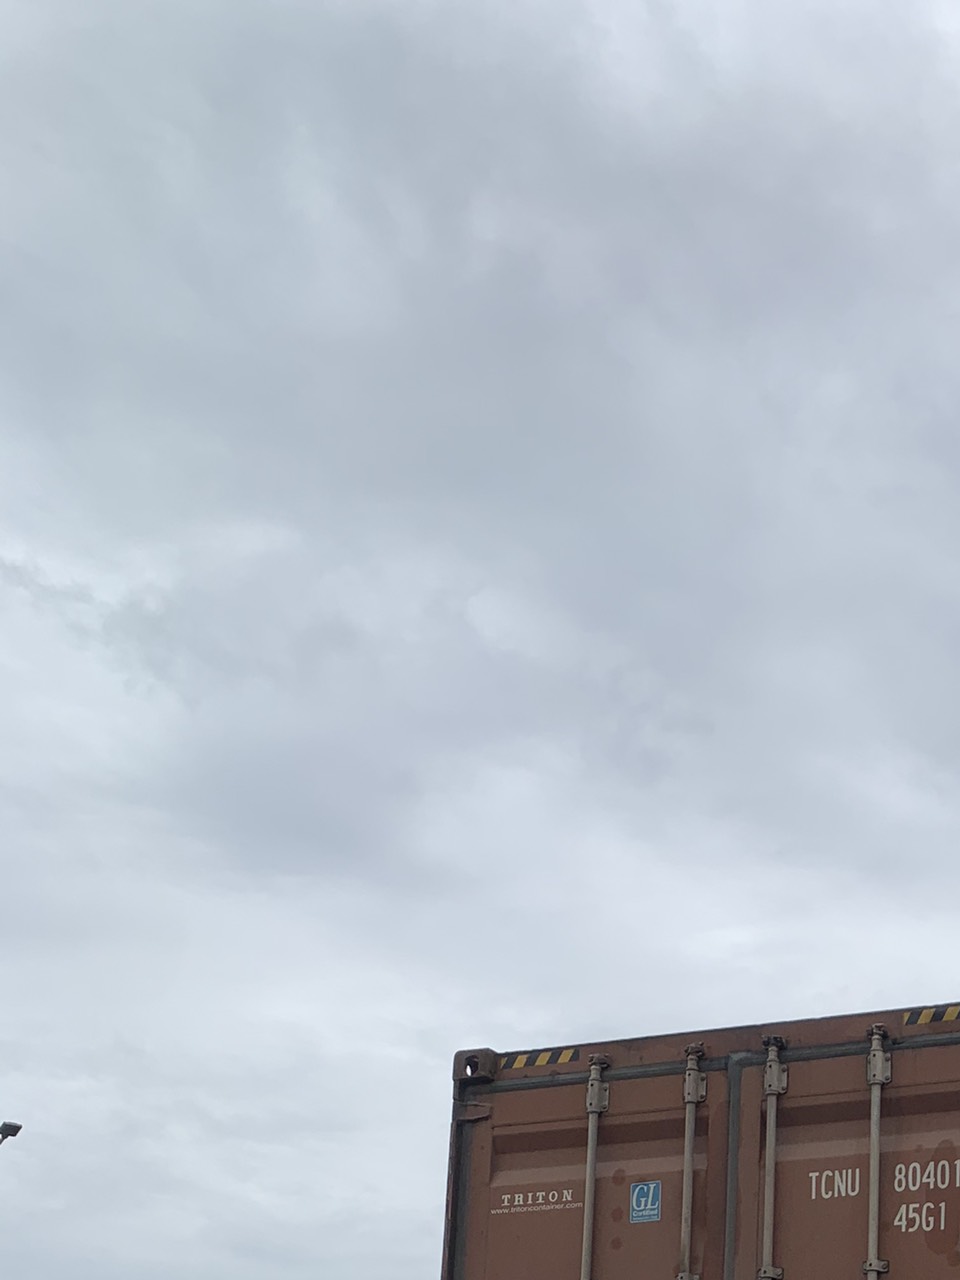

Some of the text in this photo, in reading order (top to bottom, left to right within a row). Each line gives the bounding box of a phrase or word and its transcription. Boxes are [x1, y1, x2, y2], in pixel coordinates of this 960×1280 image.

[633, 1183, 659, 1210] GL
[809, 1168, 860, 1199] TCNU
[490, 1202, 583, 1215] www.tritoncontainer.com
[501, 1190, 573, 1206] TRITON
[894, 1202, 946, 1232] 45G1
